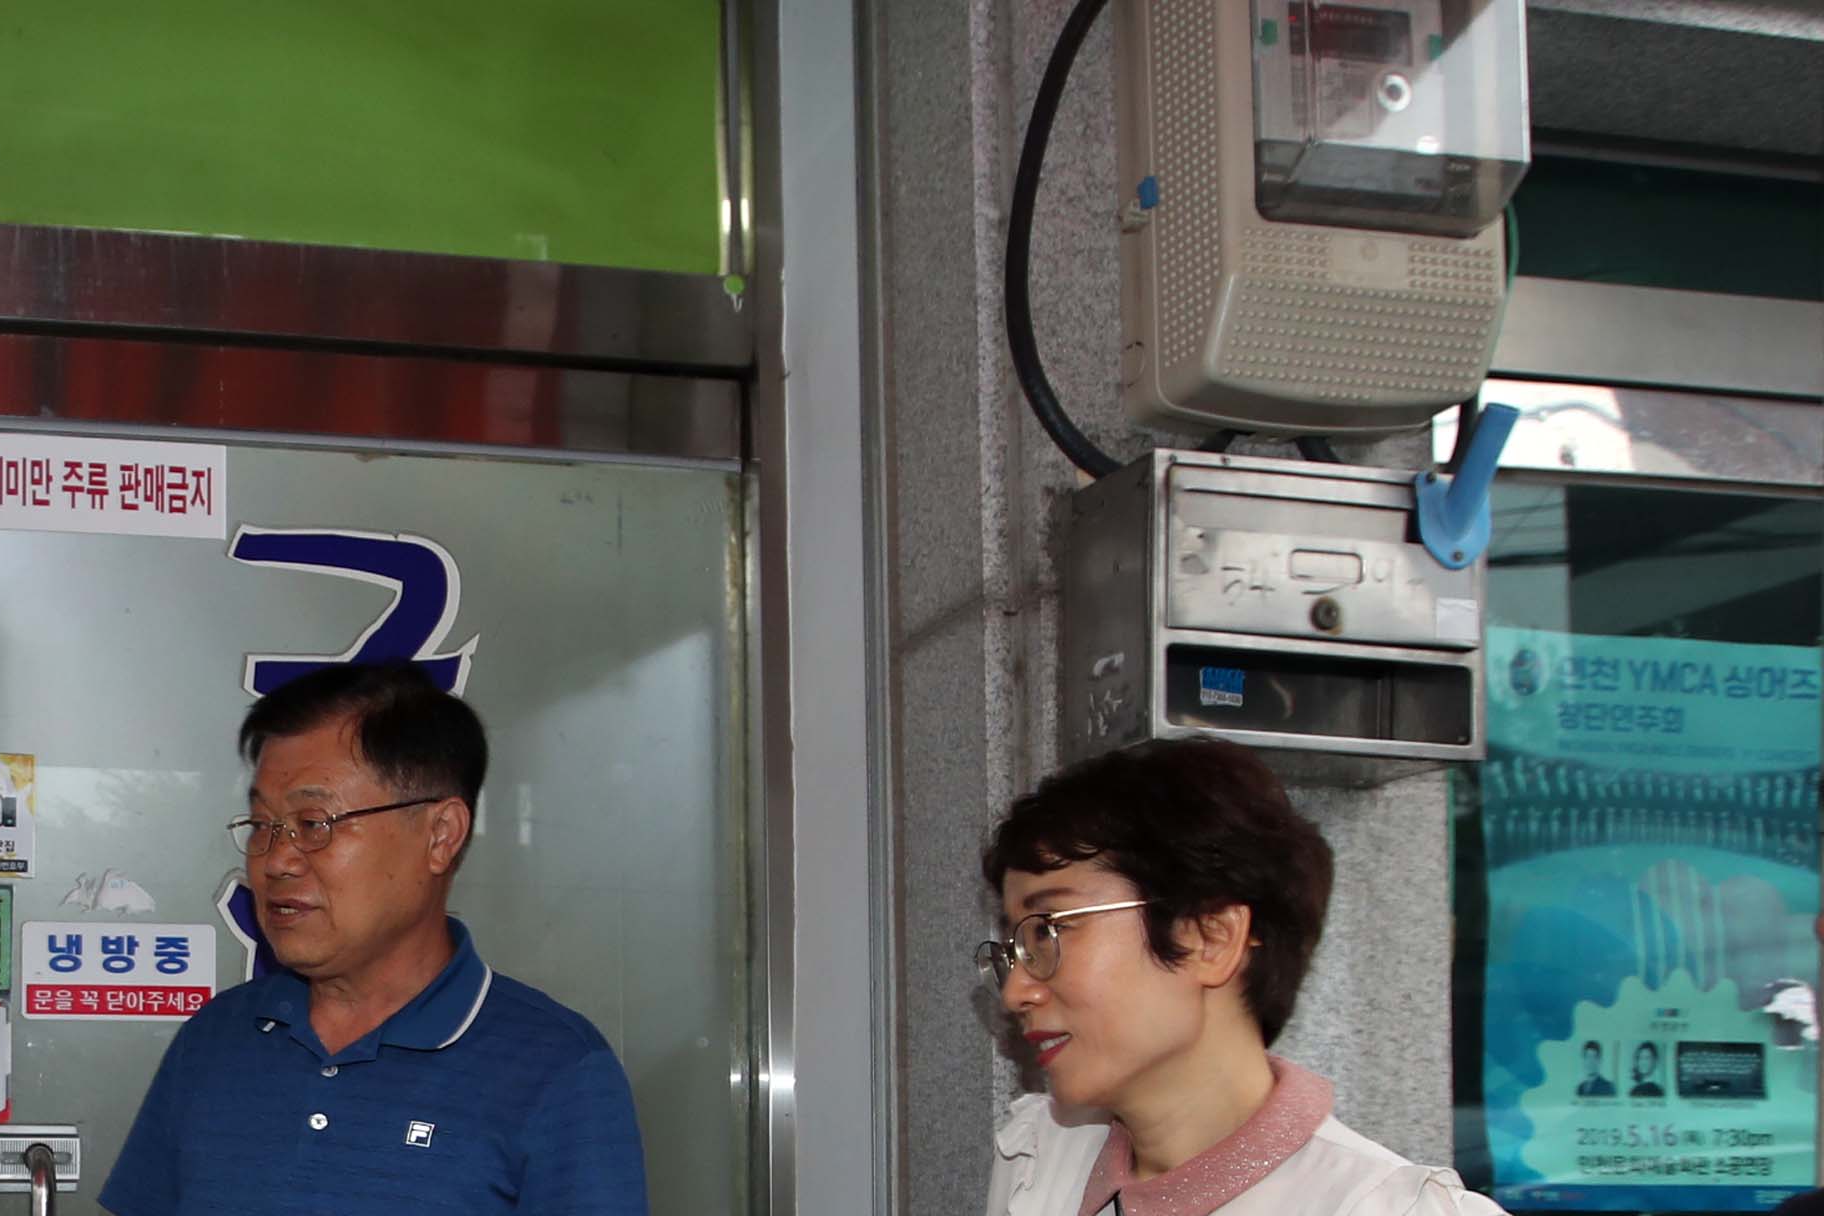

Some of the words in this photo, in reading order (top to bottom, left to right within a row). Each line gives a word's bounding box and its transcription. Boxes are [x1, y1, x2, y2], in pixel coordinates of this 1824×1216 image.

[61, 461, 109, 510] 주류
[119, 463, 213, 515] 판매금지
[1629, 660, 1718, 695] YMCA
[34, 990, 72, 1010] 문을
[80, 990, 99, 1010] 꼭
[106, 991, 203, 1011] 닫아주세요
